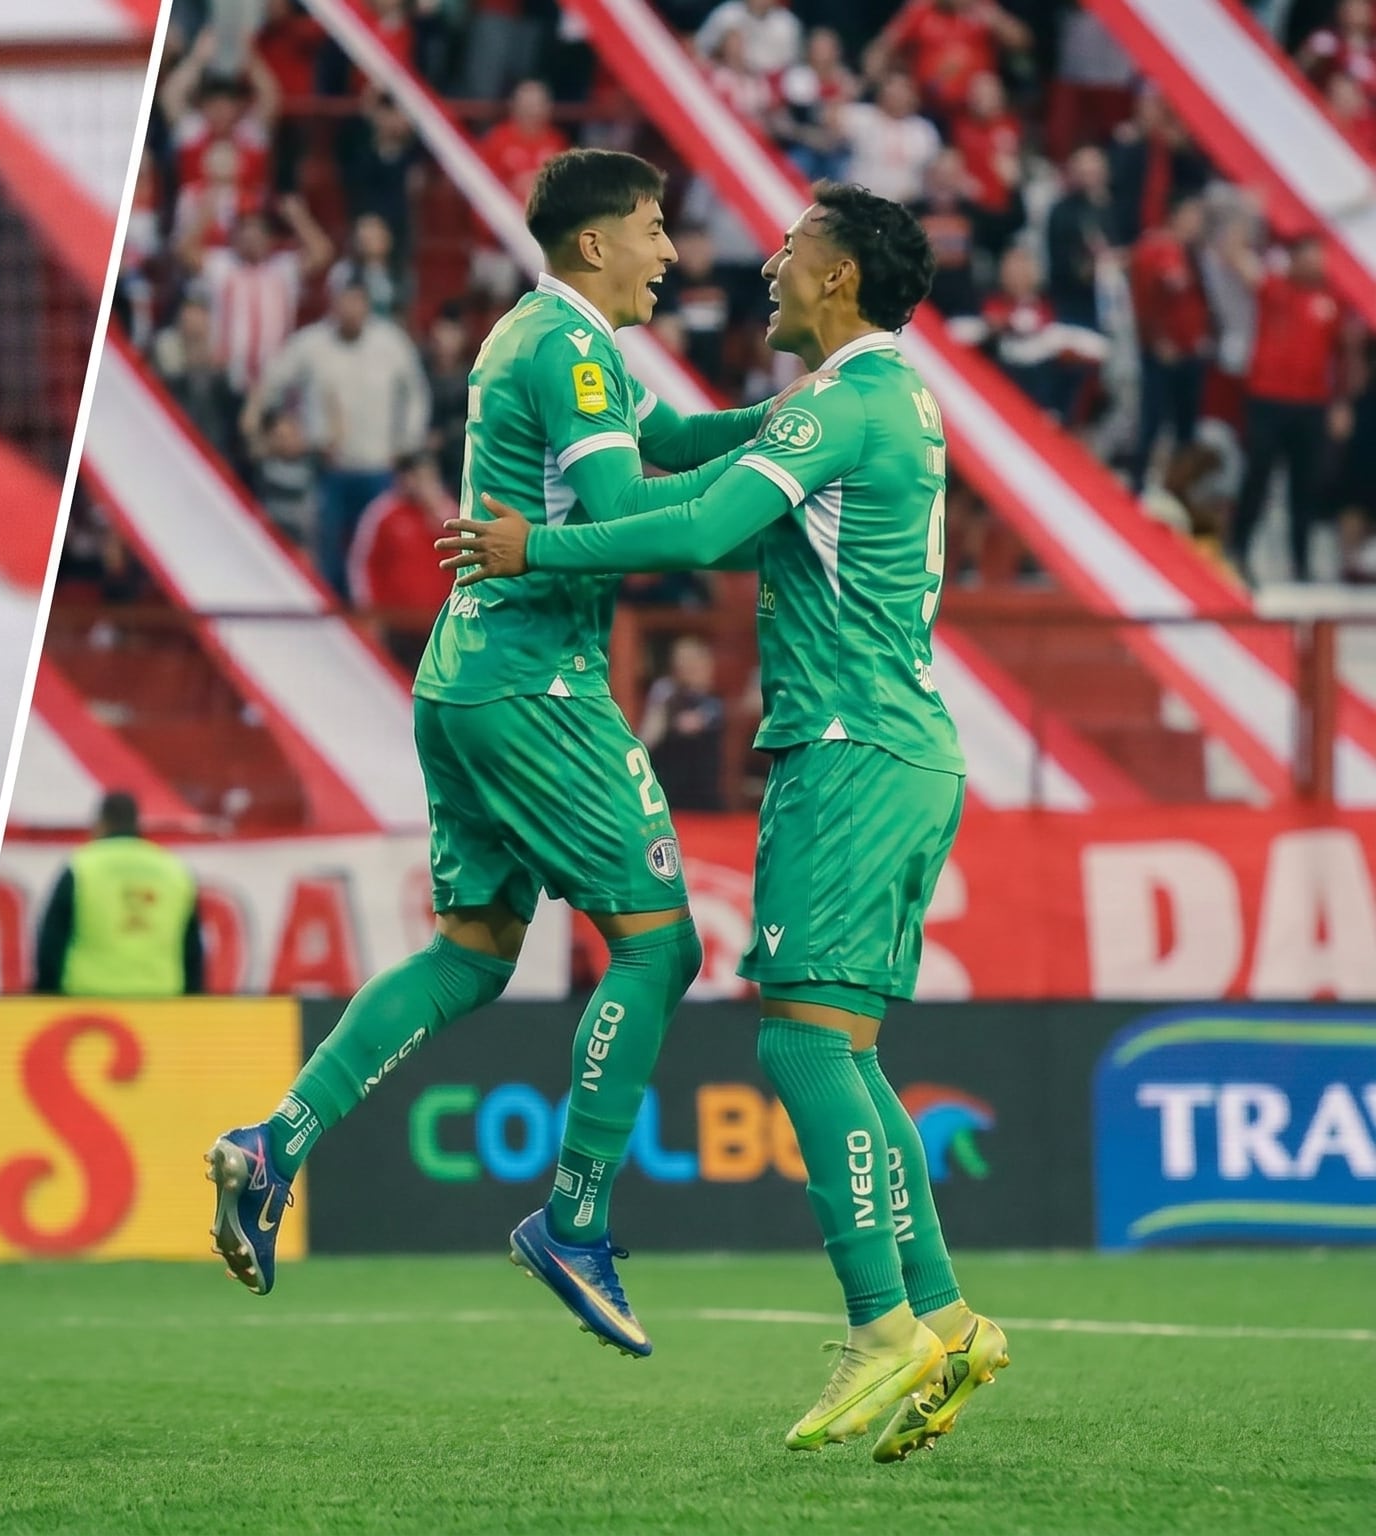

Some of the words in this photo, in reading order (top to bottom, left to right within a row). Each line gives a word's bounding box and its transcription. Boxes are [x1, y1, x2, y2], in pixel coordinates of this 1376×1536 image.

[626, 747, 664, 816] 2
[581, 1001, 625, 1092] IVECO
[846, 1130, 876, 1229] IVECO
[888, 1146, 915, 1243] IVECO
